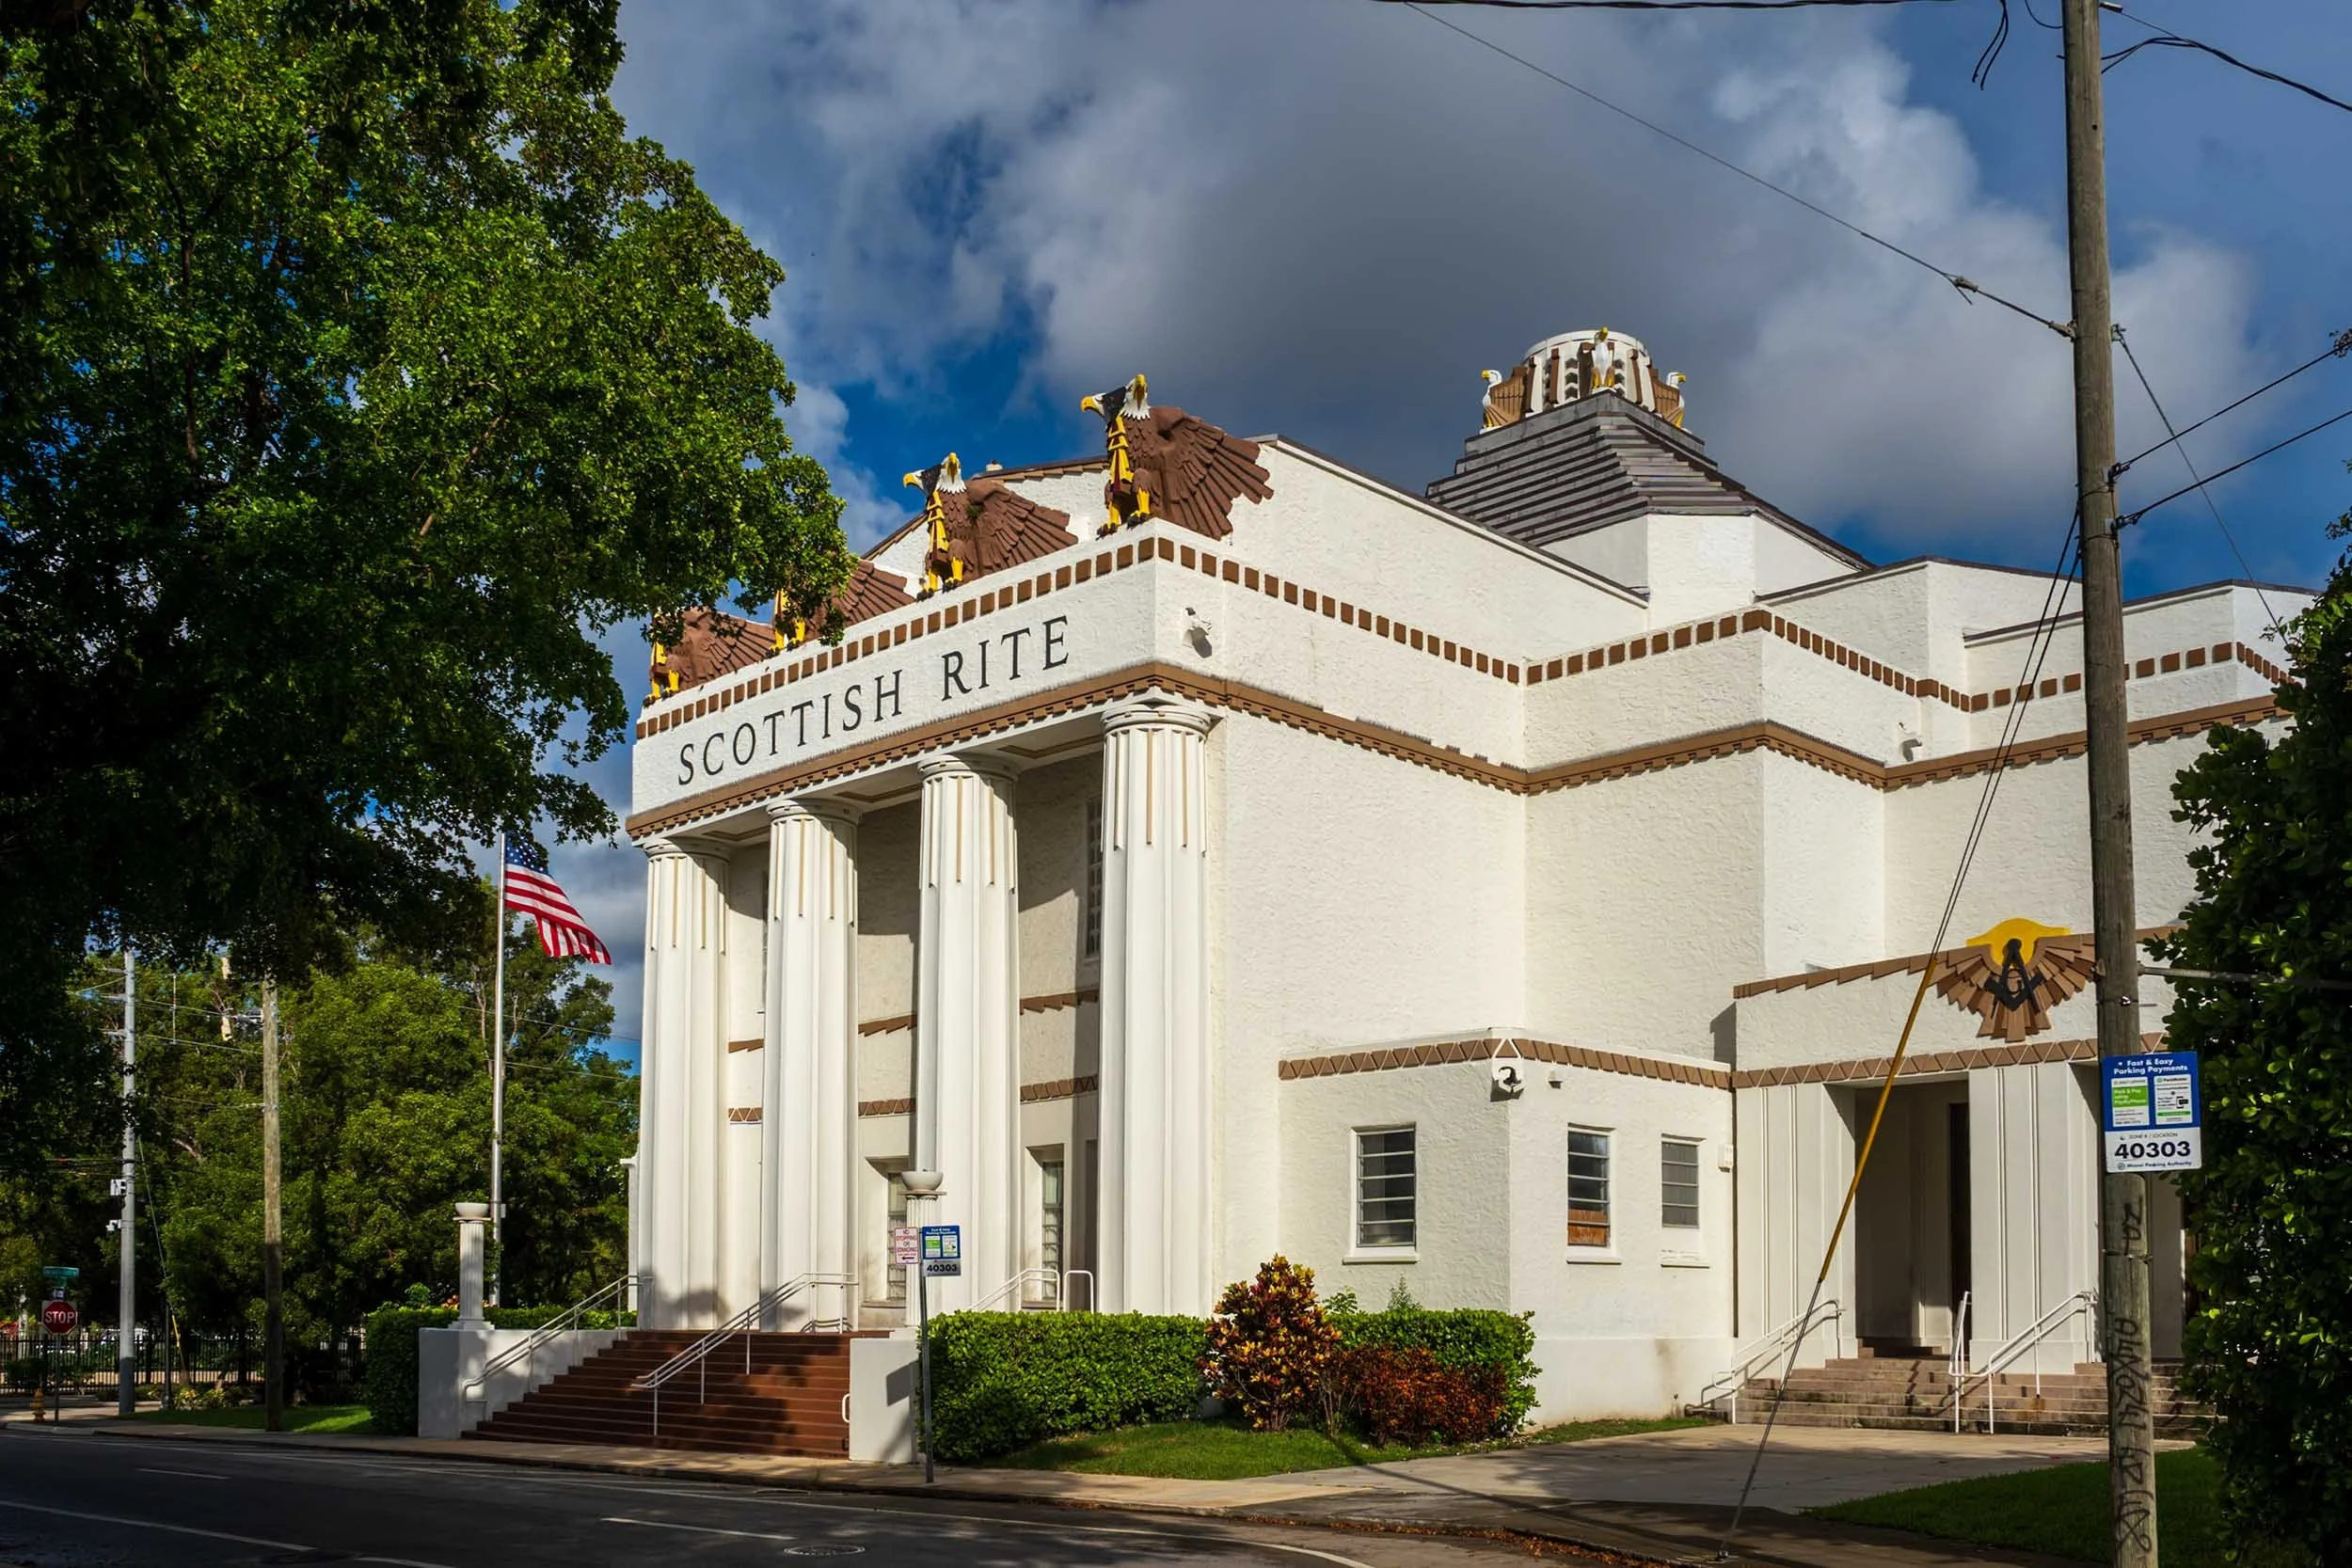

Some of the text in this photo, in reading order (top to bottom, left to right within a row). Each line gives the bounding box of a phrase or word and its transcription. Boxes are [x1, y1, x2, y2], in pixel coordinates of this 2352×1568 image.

[677, 614, 1070, 785] SCOTTISH RITE
[2113, 1065, 2188, 1075] Parking Payments
[2114, 1140, 2191, 1159] 40303
[927, 1263, 958, 1272] 40303
[44, 1310, 75, 1324] STOP
